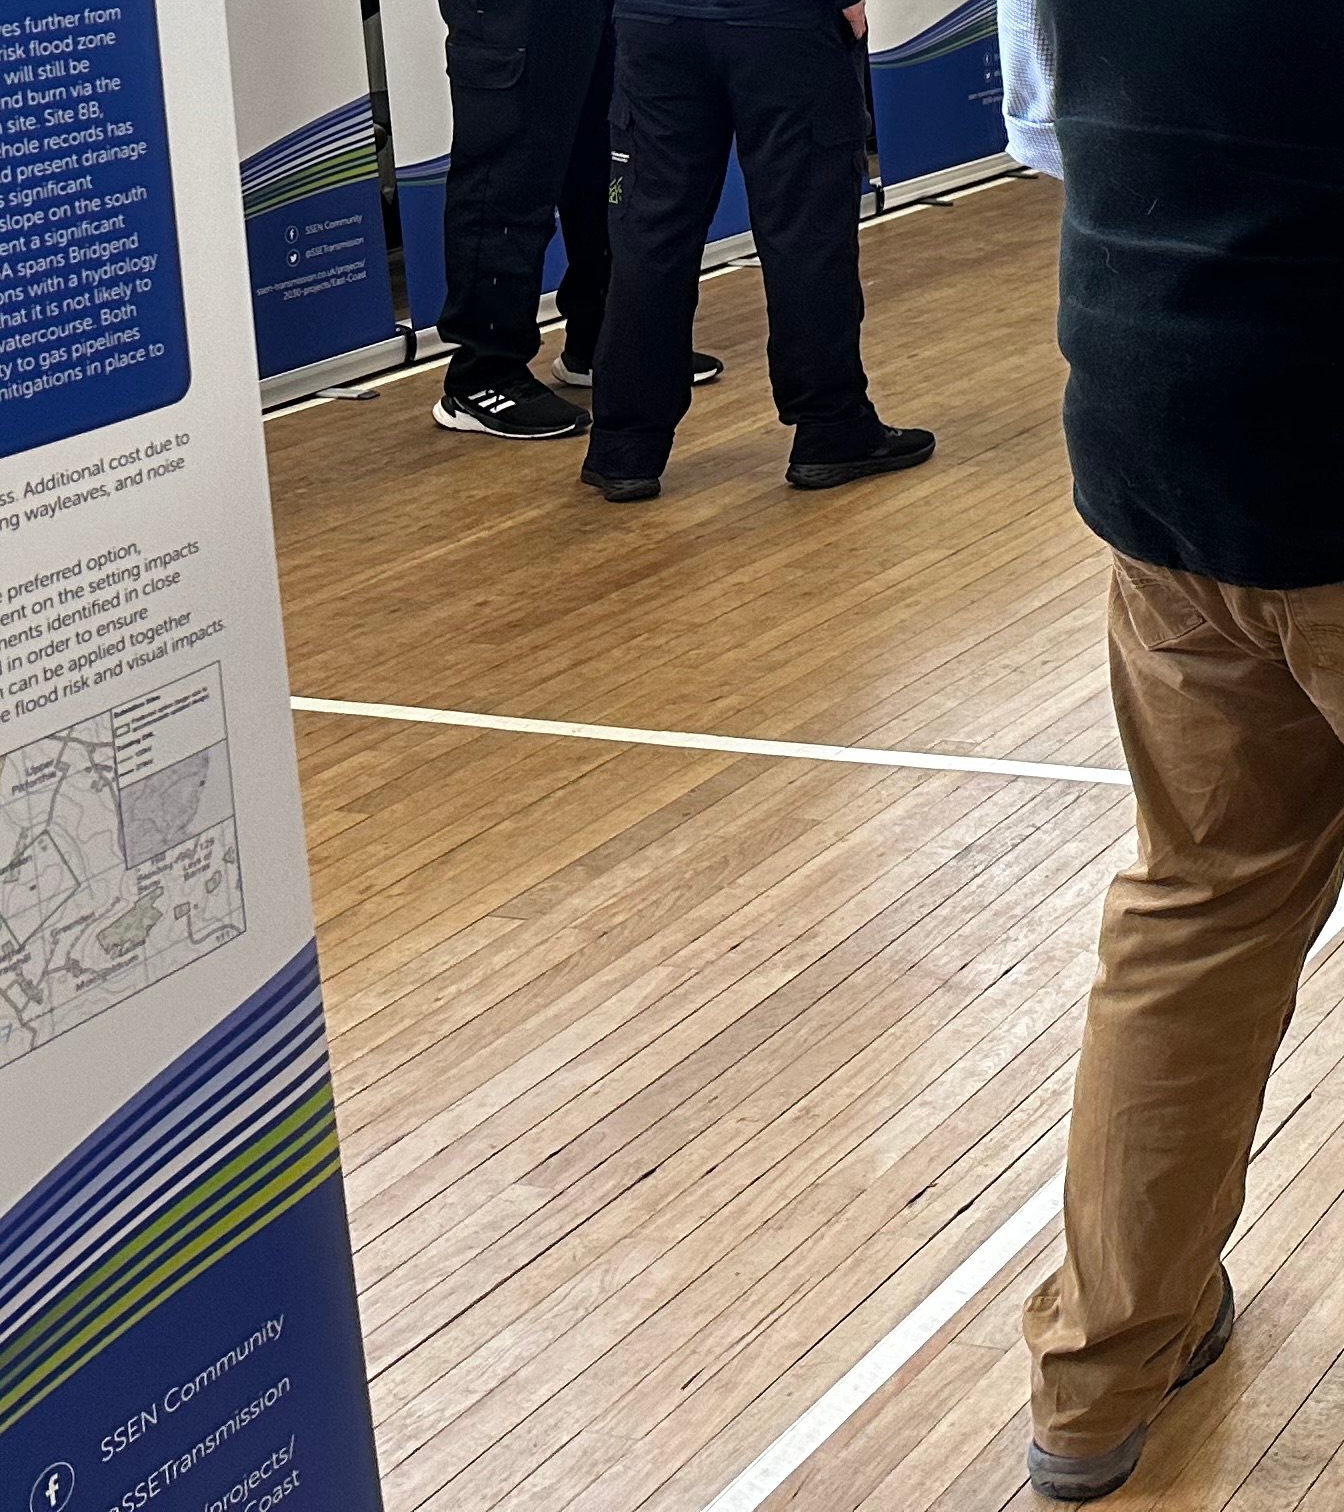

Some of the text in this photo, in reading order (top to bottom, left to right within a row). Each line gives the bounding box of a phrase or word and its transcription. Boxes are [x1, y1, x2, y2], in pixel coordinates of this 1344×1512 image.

[24, 6, 121, 35] further from
[29, 31, 116, 57] flood zone
[4, 59, 66, 85] will still
[43, 118, 134, 151] records has
[17, 139, 148, 184] present drainage
[8, 174, 93, 208] significant
[104, 185, 148, 208] south
[44, 214, 125, 246] significant
[305, 214, 363, 235] SSEN Community
[17, 232, 140, 280] spans Bridgend
[82, 252, 158, 287] hydrology
[94, 282, 133, 306] likely
[39, 325, 142, 371] gas pipelines
[104, 345, 147, 376] place
[23, 447, 142, 499] Additional cost
[24, 457, 187, 523] wayleaves, noise
[7, 541, 142, 607] preferred option,
[89, 540, 200, 597] setting impacts
[46, 569, 182, 634] identified close
[27, 606, 149, 666] order ensure
[68, 610, 193, 675] applied together
[15, 616, 227, 720] flood visual impacts.
[101, 1313, 284, 1464] SSEN Community
